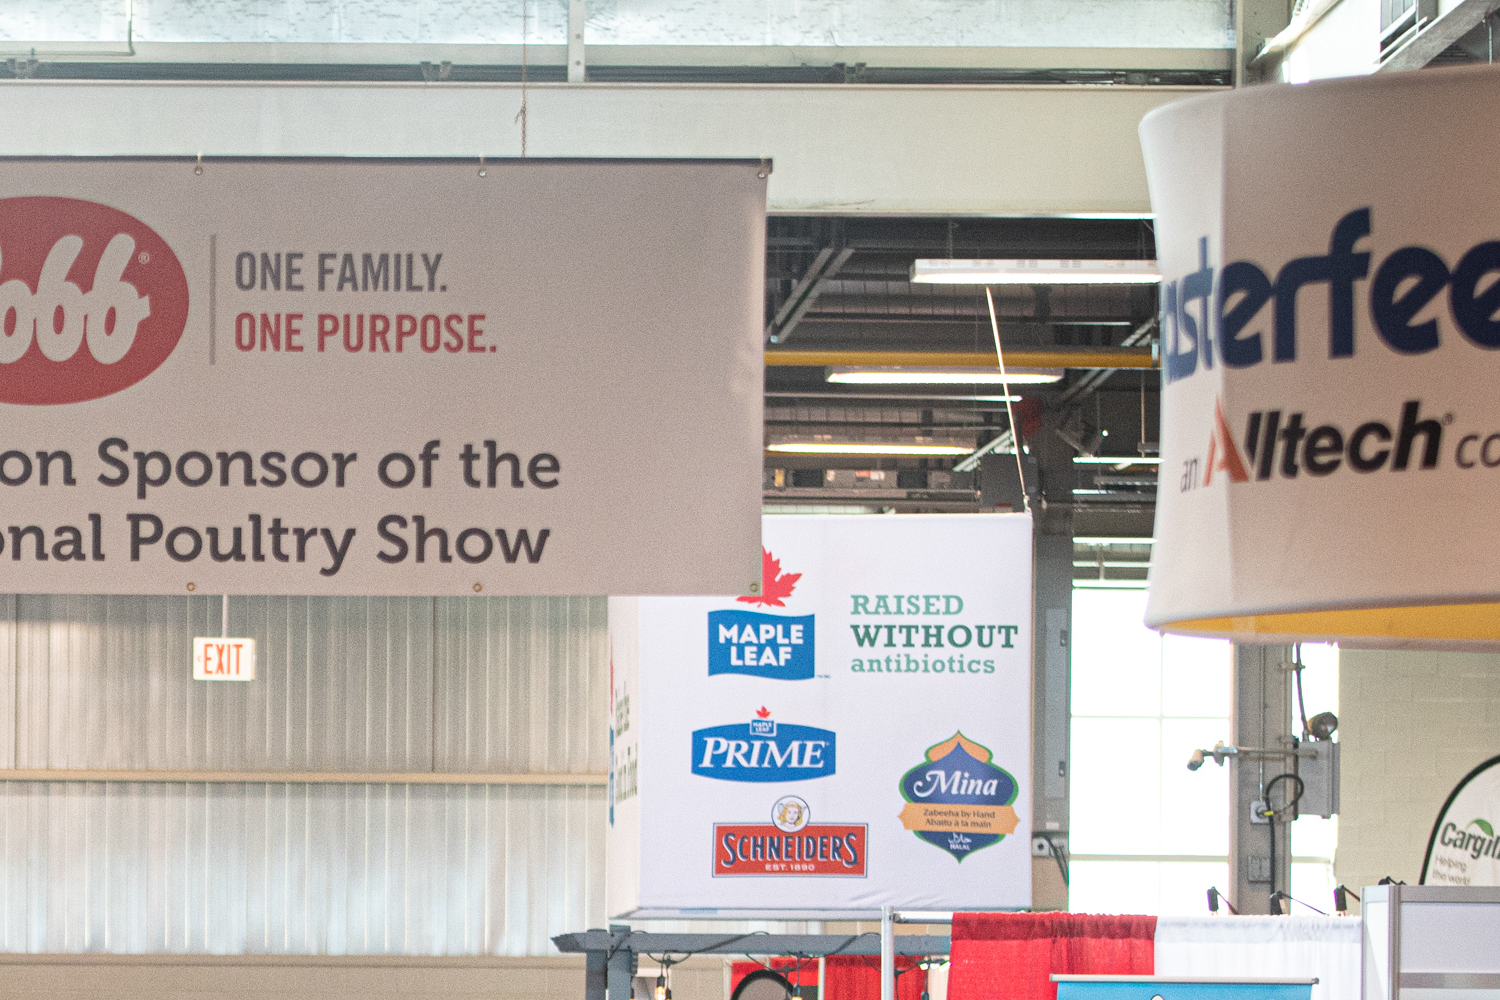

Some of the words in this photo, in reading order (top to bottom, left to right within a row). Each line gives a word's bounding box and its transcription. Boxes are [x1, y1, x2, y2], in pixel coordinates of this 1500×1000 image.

[233, 251, 305, 292] ONE
[317, 251, 448, 293] FAMILY.
[233, 313, 305, 353] ONE
[317, 313, 497, 354] PURPOSE.
[1180, 457, 1199, 494] an
[1202, 394, 1443, 488] Alltech
[97, 437, 358, 500] Sponsor
[377, 439, 443, 489] of
[459, 440, 562, 489] the
[126, 513, 357, 577] Poultry
[375, 514, 551, 564] Show
[850, 594, 964, 616] RAISED
[718, 624, 804, 645] MAPLE
[850, 623, 1019, 649] WITHOUT
[203, 643, 243, 675] EXIT
[730, 646, 792, 667] LEAF
[850, 653, 996, 674] antibiotics
[698, 737, 826, 769] PRIME
[913, 769, 999, 798] Mina
[721, 832, 859, 869] SCHNEIDERS
[1440, 821, 1500, 860] Cargil
[765, 863, 789, 872] EST.
